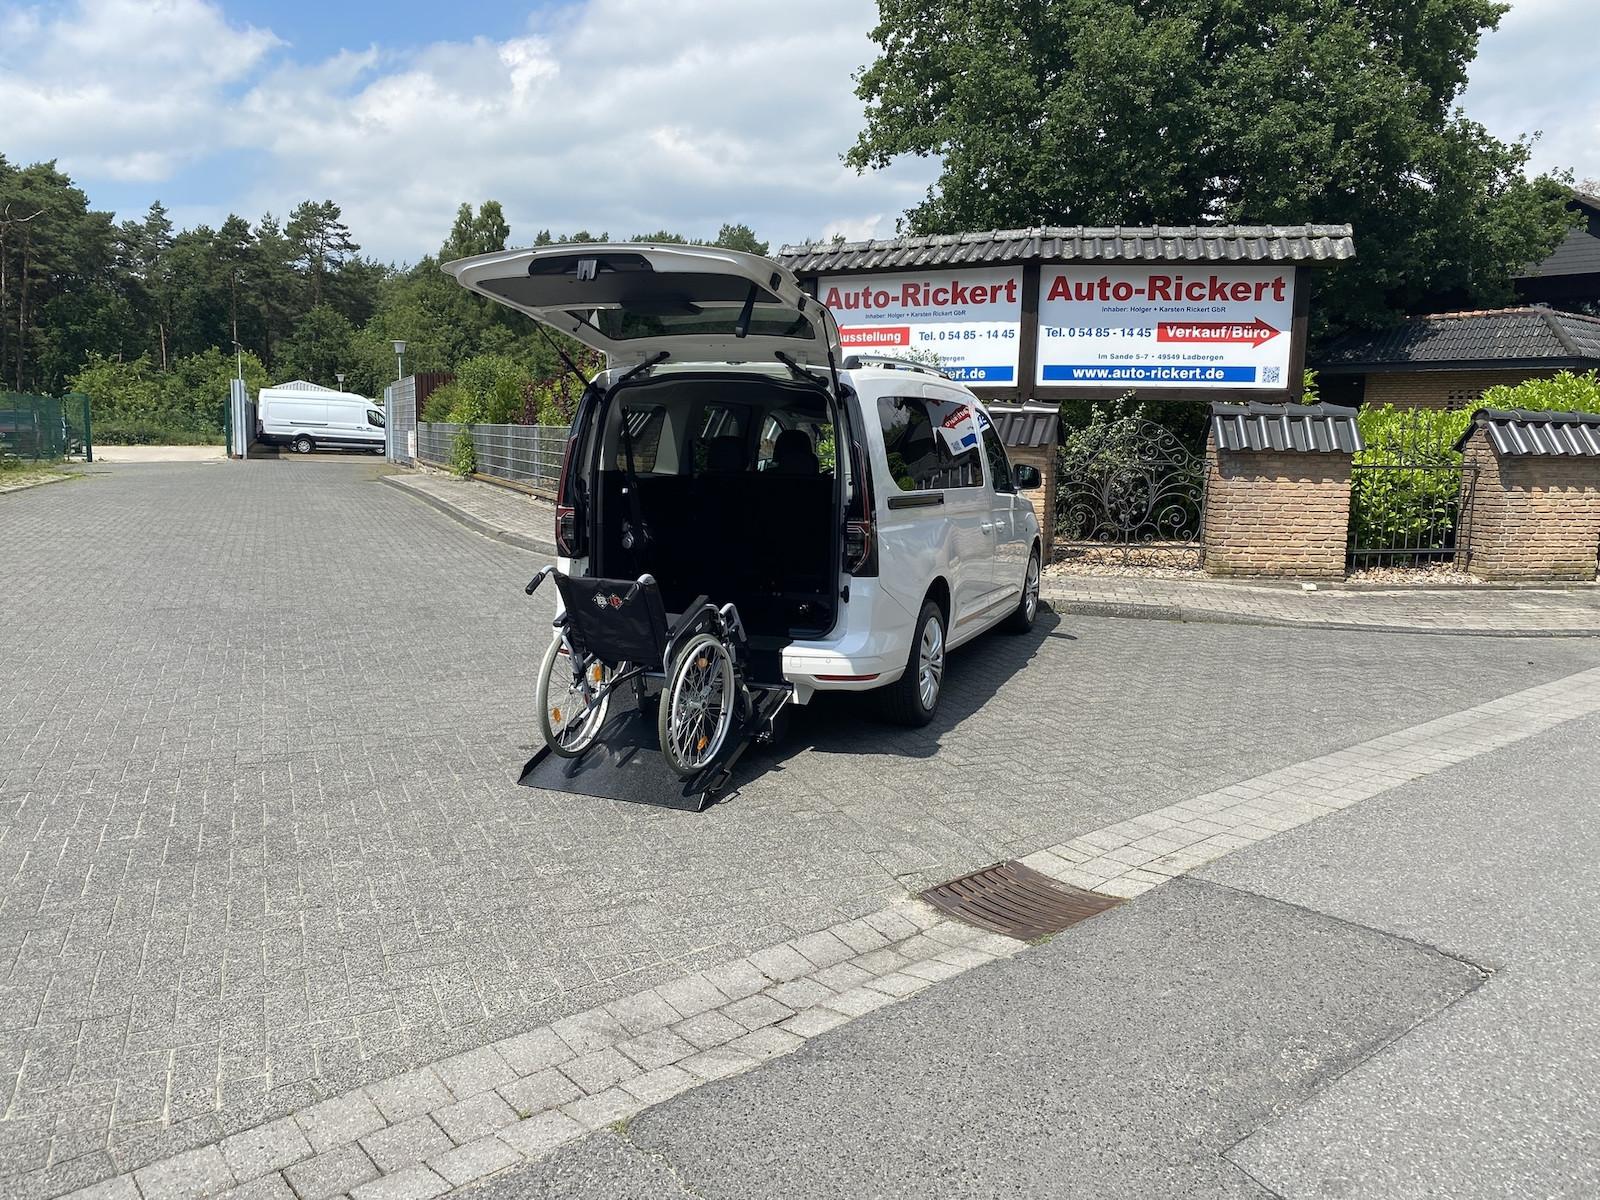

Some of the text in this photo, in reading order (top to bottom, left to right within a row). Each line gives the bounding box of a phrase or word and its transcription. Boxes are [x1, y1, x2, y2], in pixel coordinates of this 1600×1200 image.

[825, 278, 1017, 310] Auto-Rickert
[1047, 275, 1286, 302] Auto-Rickert
[1130, 306, 1152, 314] Holger
[887, 312, 905, 320] Holger
[919, 331, 936, 341] Tel.
[1045, 327, 1065, 338] Tel.
[1166, 325, 1270, 339] Verkauf/Büro
[1157, 353, 1180, 361] 49549
[1182, 353, 1224, 361] Ladbergen
[1072, 367, 1225, 379] www.auto-rickert.de
